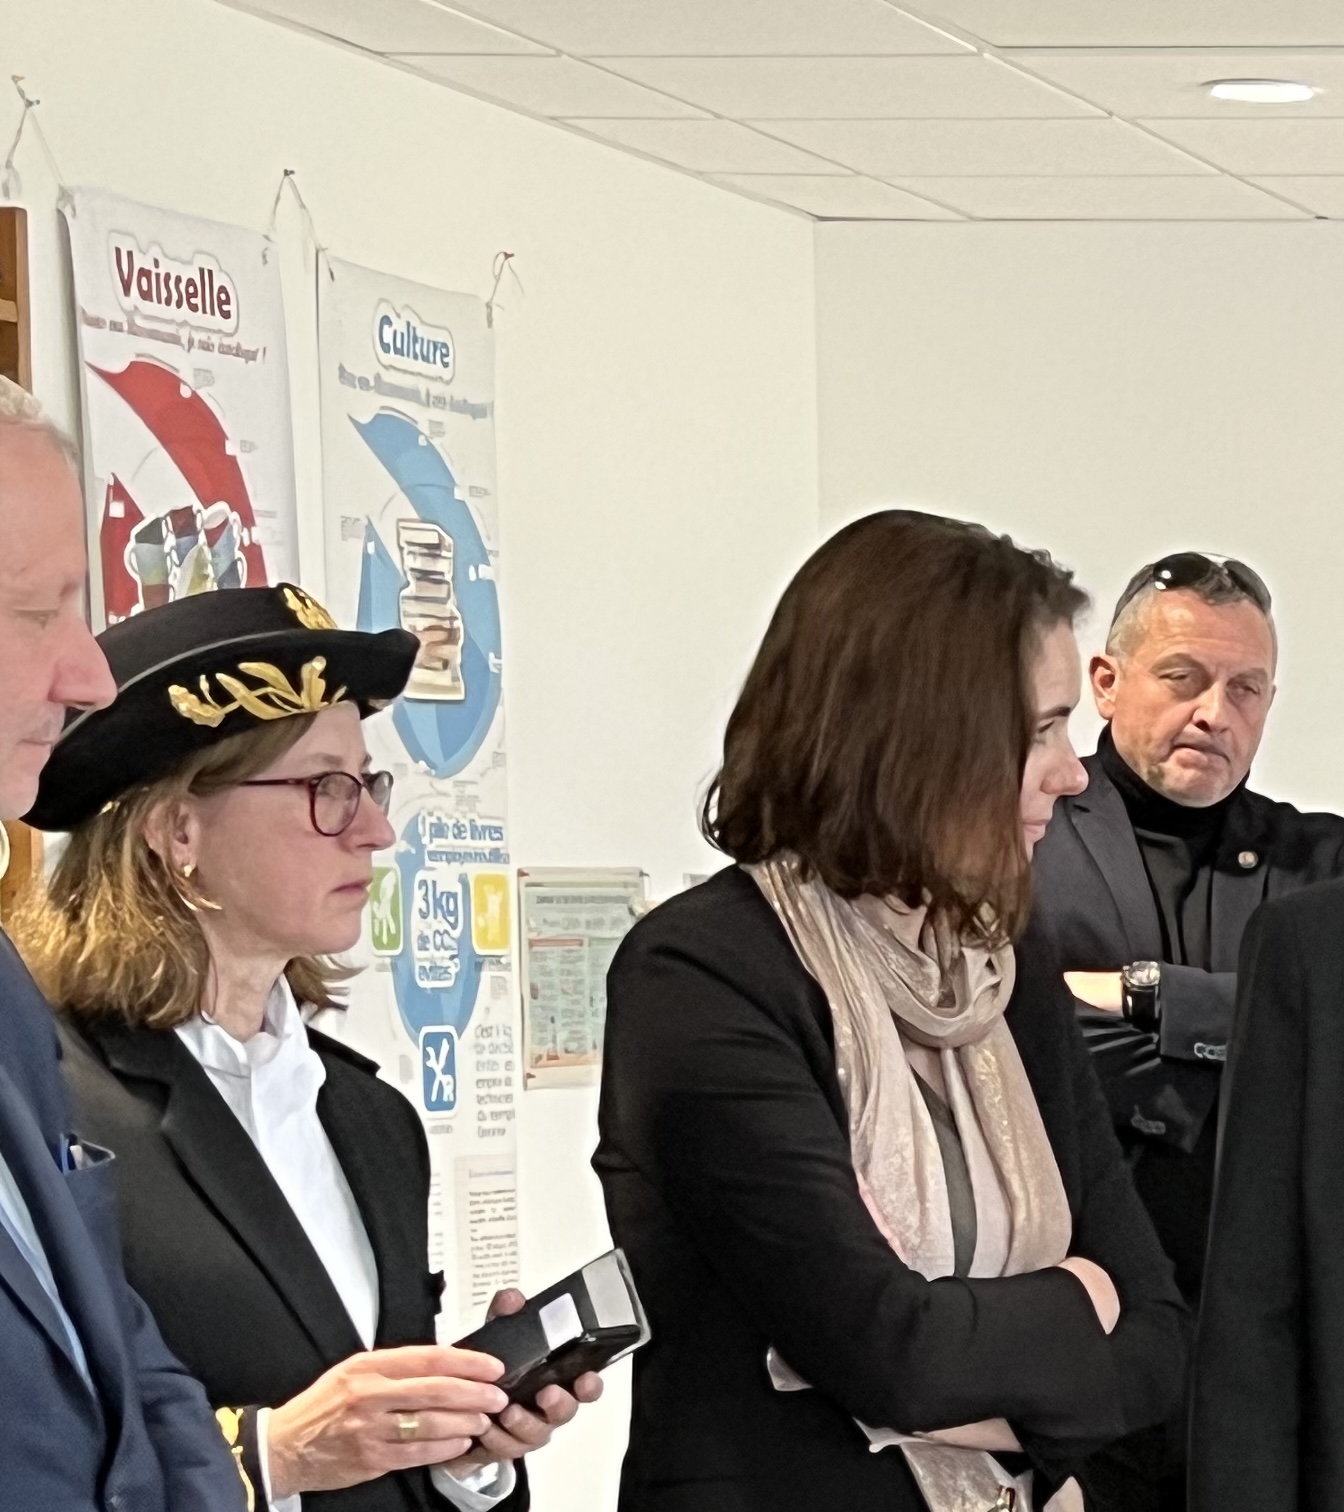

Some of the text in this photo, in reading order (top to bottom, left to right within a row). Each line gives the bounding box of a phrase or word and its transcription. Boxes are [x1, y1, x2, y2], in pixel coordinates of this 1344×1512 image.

[115, 246, 231, 319] Vaisselle
[378, 315, 450, 368] Culture
[469, 819, 504, 841] livres
